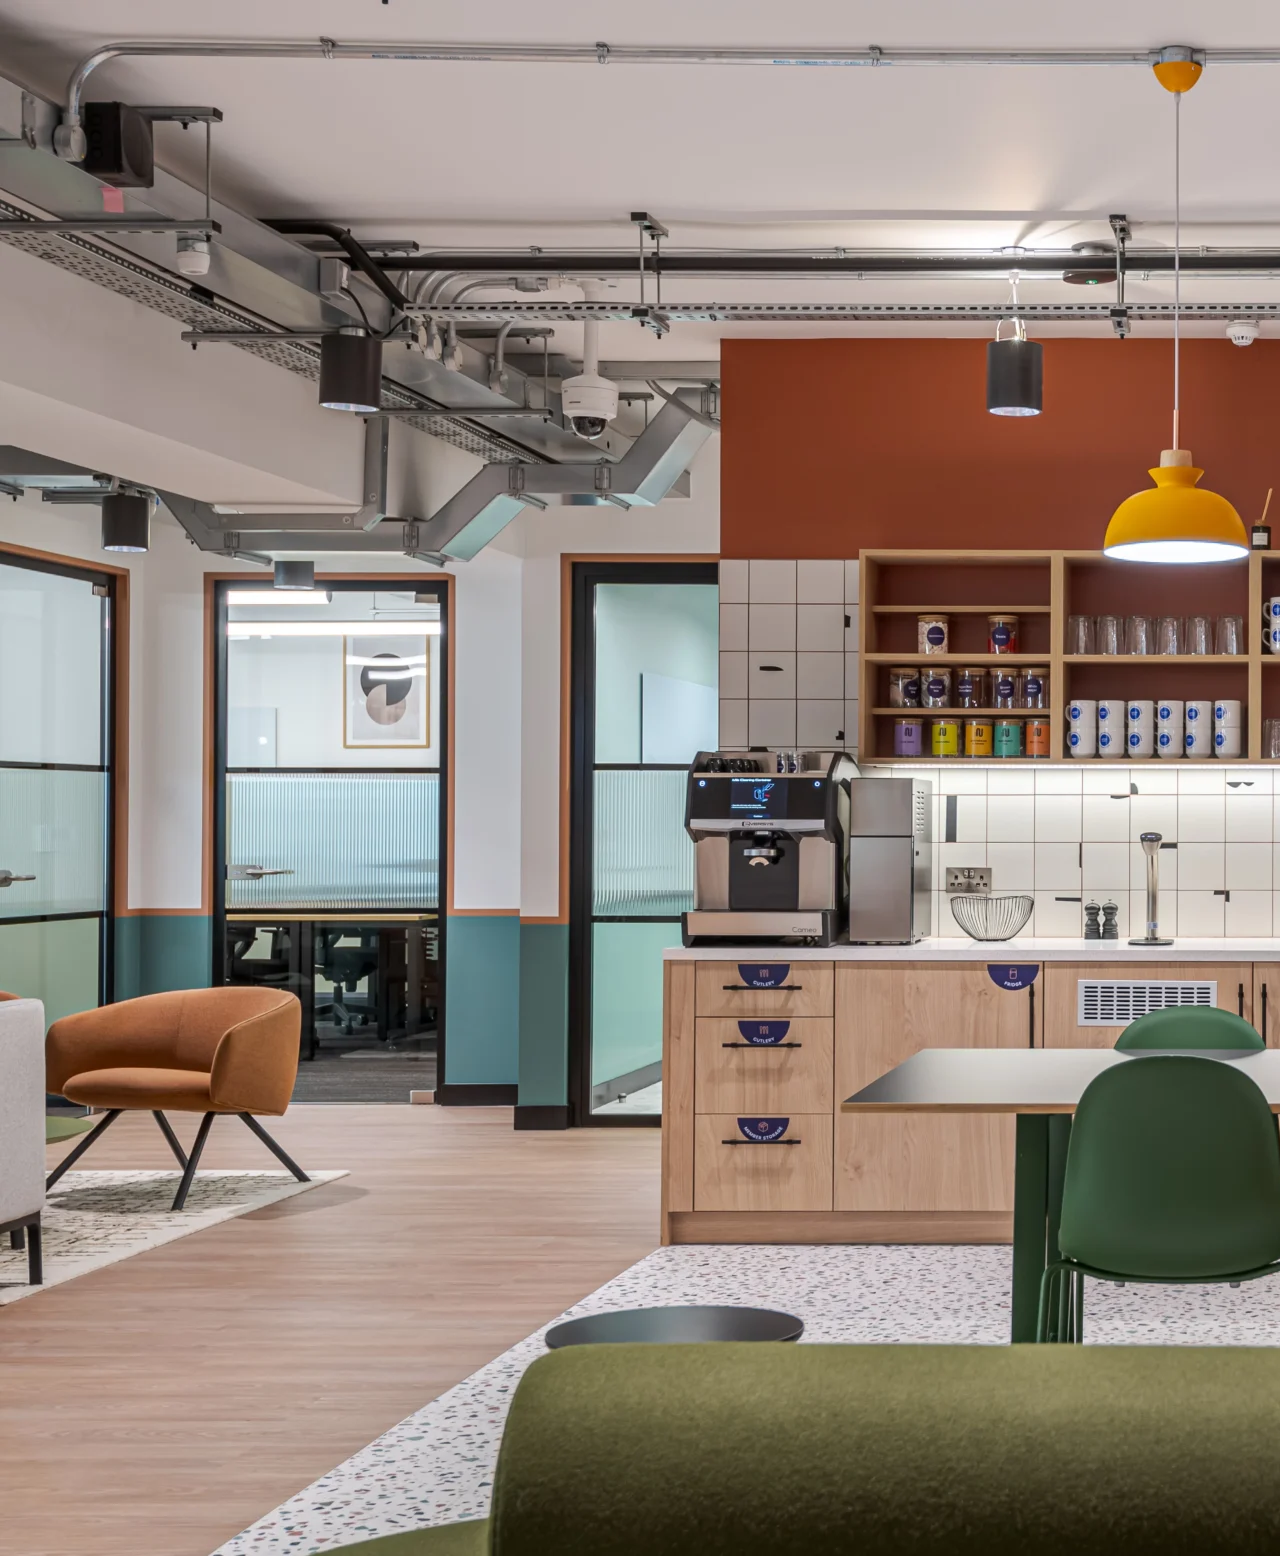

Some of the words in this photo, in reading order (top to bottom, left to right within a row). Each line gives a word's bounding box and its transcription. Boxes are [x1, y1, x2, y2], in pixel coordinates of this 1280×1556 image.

[753, 1036, 775, 1044] CUTLERY
[743, 1126, 762, 1140] MEMBER
[762, 1126, 783, 1140] STORAGE
